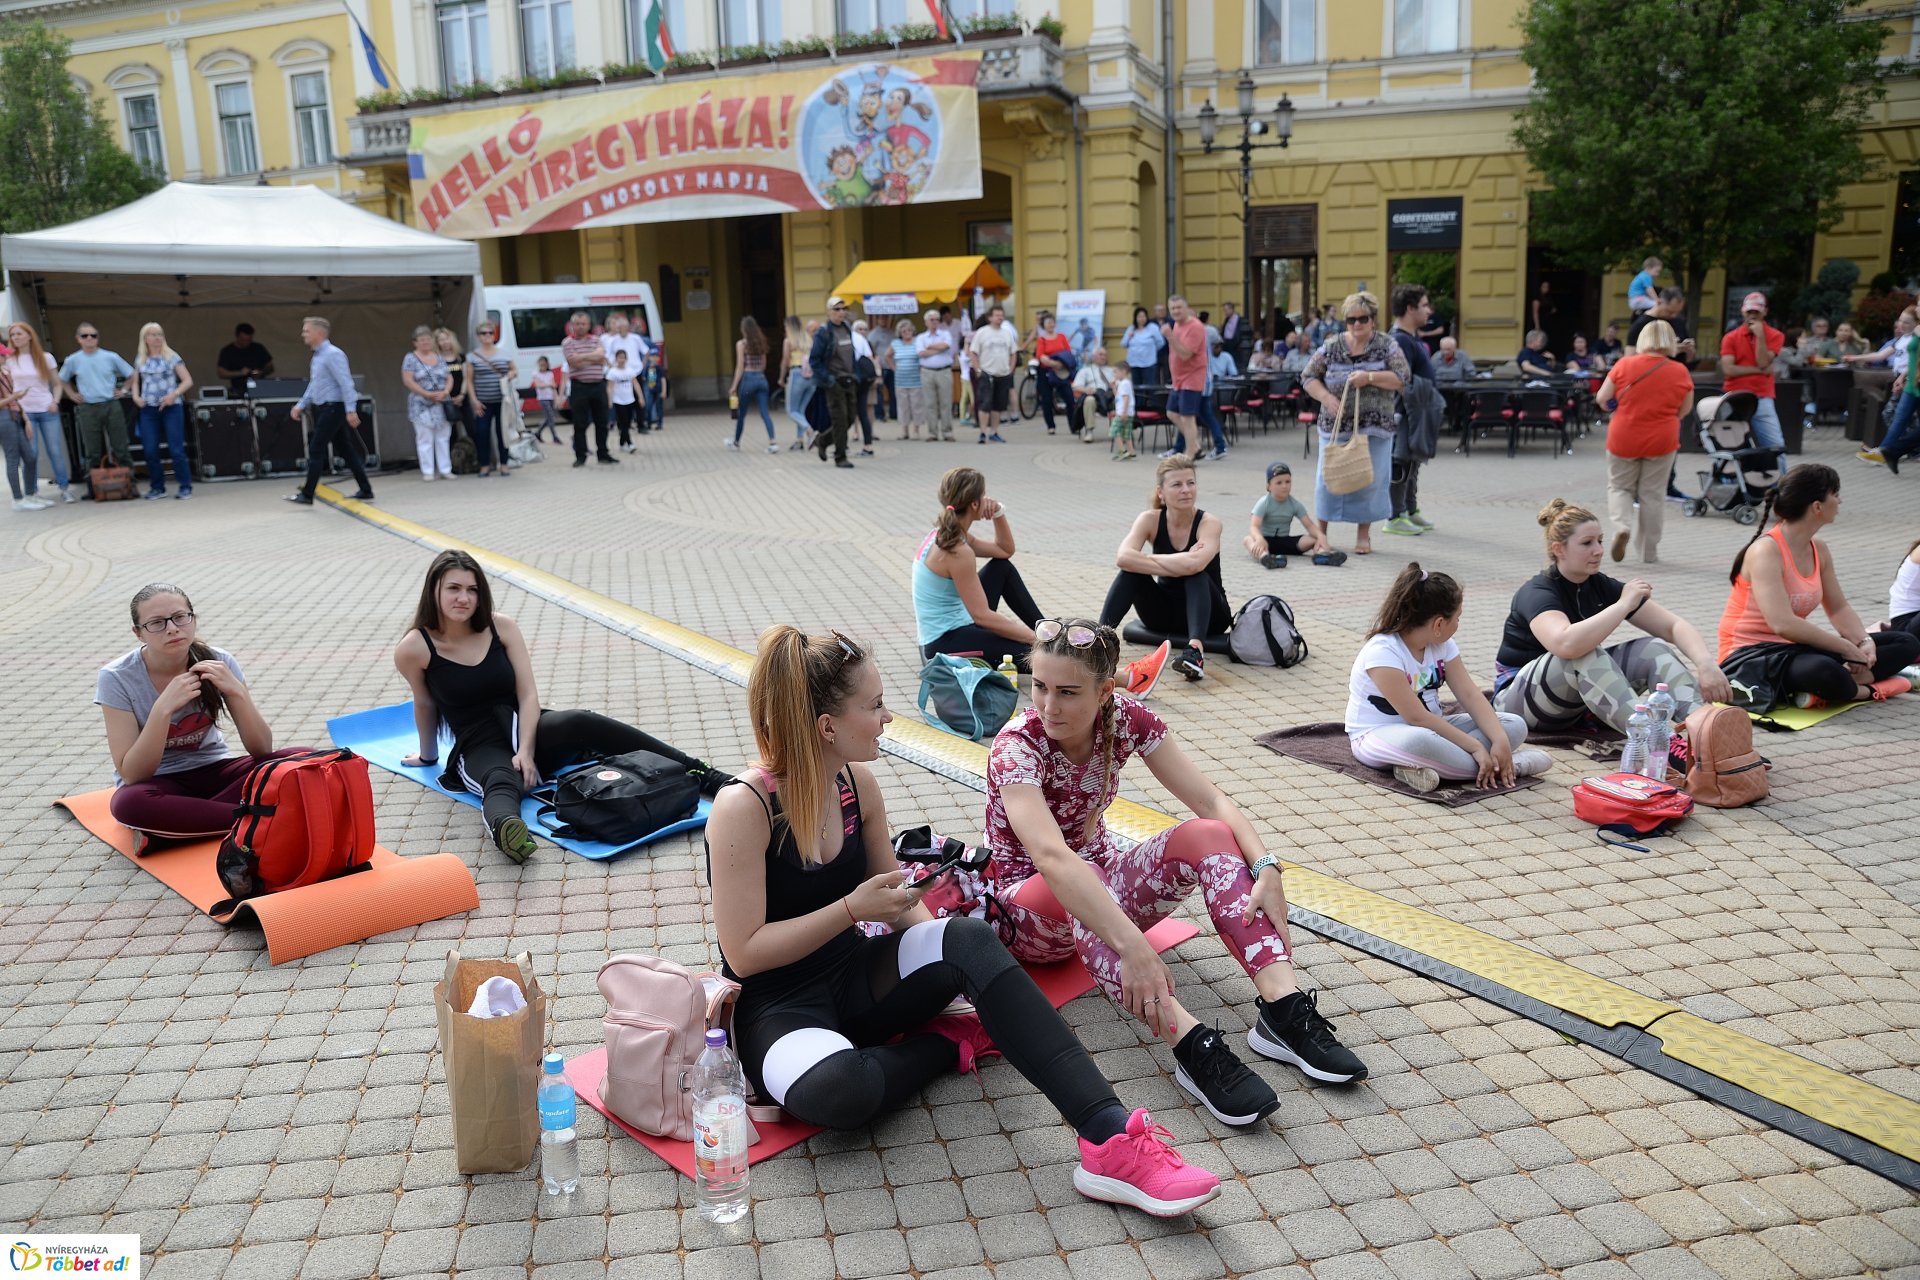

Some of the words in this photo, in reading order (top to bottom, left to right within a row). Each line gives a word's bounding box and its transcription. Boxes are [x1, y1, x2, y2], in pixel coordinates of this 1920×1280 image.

[420, 110, 542, 232] HELLÓ
[484, 91, 795, 228] NYÍREGYHÁZA!
[582, 201, 594, 218] A
[601, 174, 685, 210] MOSOLY
[696, 170, 769, 192] NAPJA
[1392, 211, 1458, 223] CONTINENT
[545, 1108, 570, 1117] update
